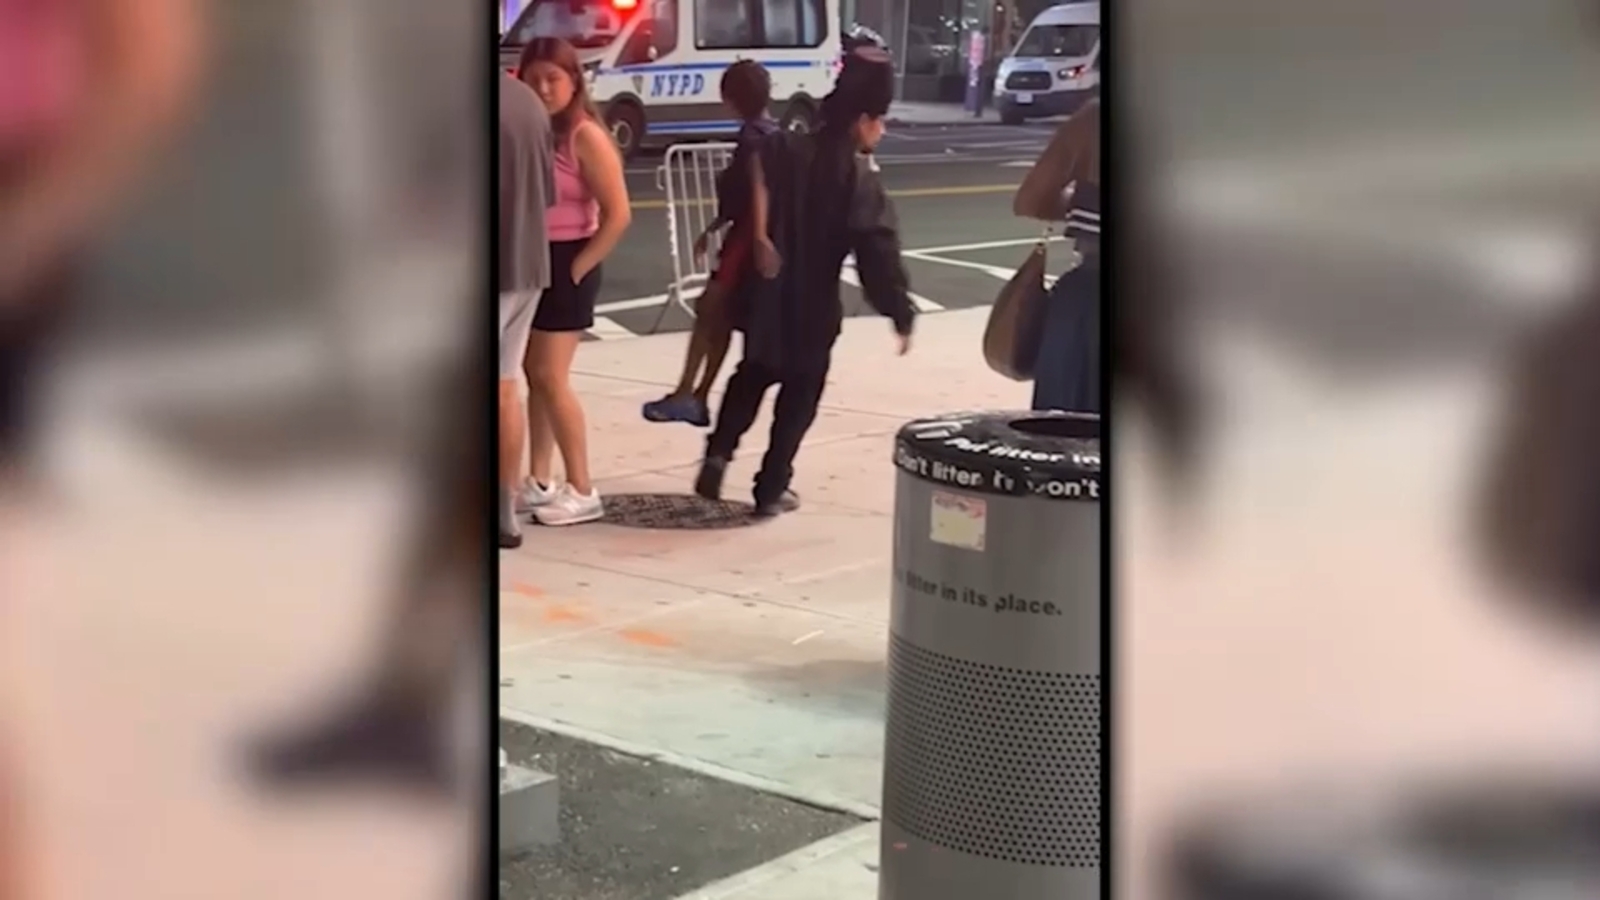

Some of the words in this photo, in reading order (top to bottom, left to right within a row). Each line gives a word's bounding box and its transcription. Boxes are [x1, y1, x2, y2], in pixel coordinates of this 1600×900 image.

[651, 73, 705, 97] NYPD
[988, 444, 1065, 463] litter
[932, 460, 981, 486] litter
[905, 570, 938, 595] litter
[941, 581, 959, 602] in
[963, 586, 988, 608] its
[994, 593, 1063, 617] place.
